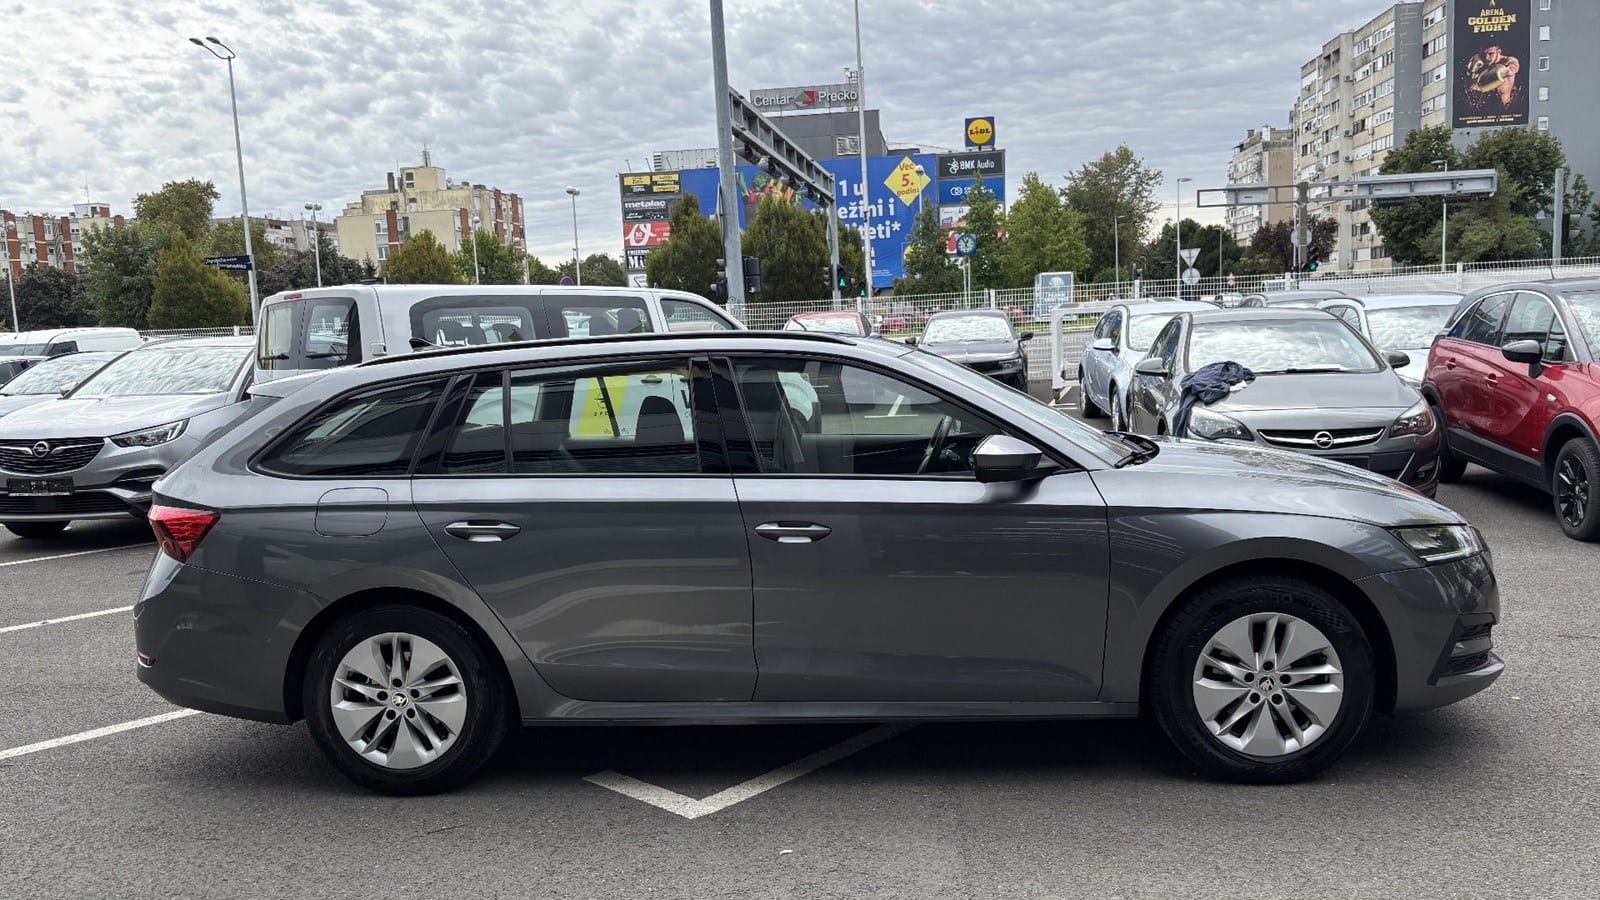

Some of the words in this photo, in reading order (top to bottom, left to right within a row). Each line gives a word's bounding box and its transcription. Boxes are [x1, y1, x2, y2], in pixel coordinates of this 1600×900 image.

[1480, 8, 1504, 16] ARENA
[1467, 14, 1517, 25] GOLDEN
[1473, 23, 1511, 33] FIGHT
[753, 94, 790, 106] Centar
[960, 159, 975, 170] BMK
[976, 159, 995, 168] Audio
[901, 173, 914, 187] 5.
[838, 179, 848, 197] 1
[888, 198, 895, 216] i
